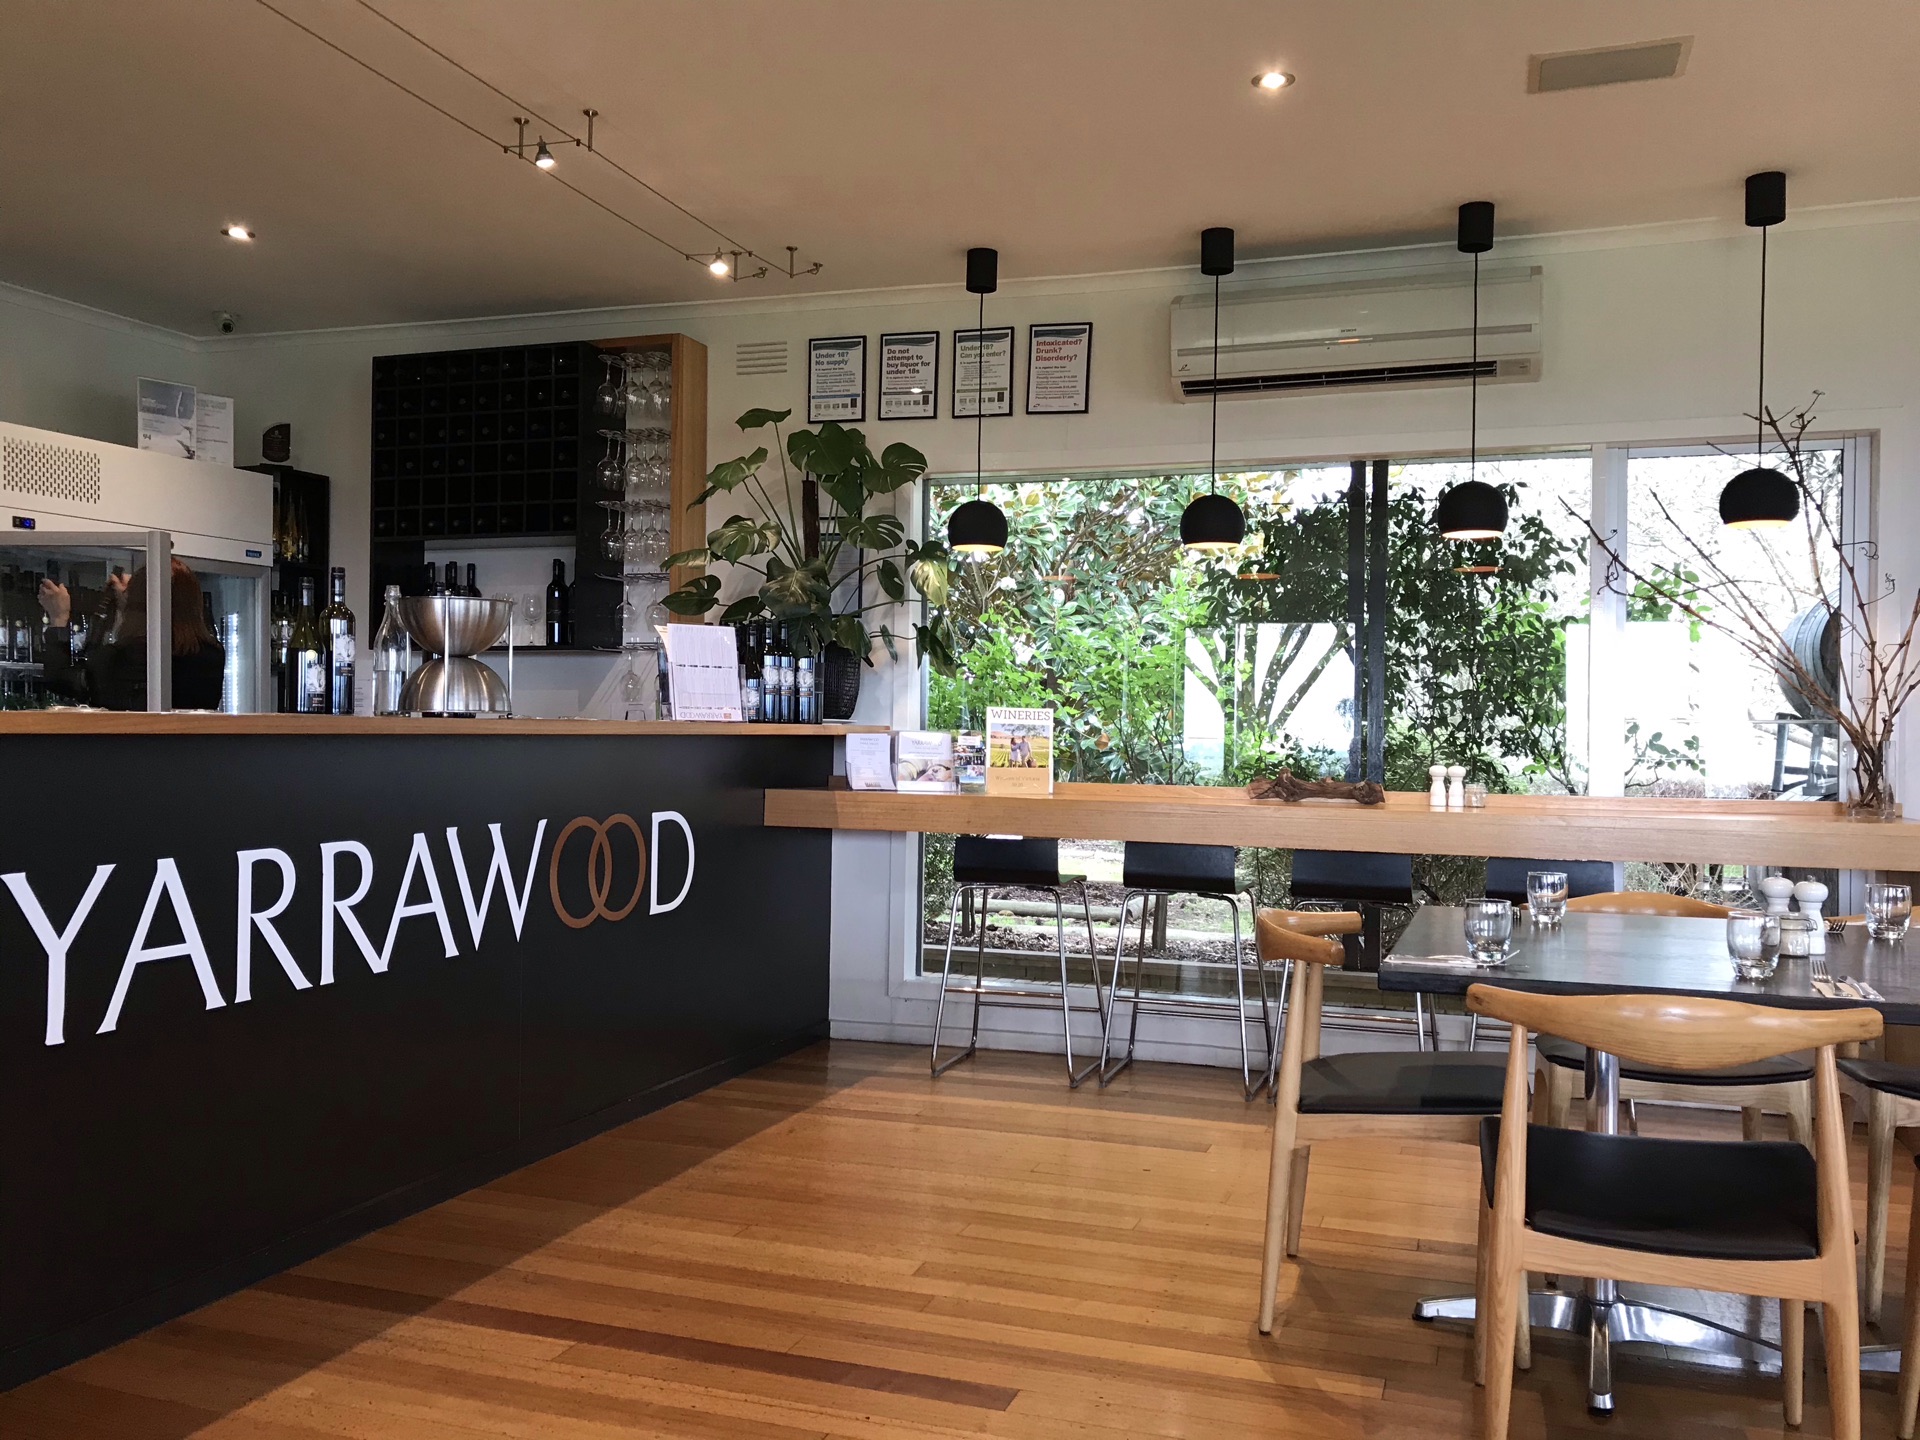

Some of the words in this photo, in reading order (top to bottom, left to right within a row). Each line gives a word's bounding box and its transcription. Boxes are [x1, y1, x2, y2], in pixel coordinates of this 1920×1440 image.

[1036, 339, 1083, 347] Intoxicated?
[886, 354, 914, 362] attempt
[986, 350, 1006, 358] enter?
[1035, 354, 1078, 362] Disorderly?
[991, 709, 1051, 721] WINERIES
[0, 810, 696, 1046] YARRAWOOD
